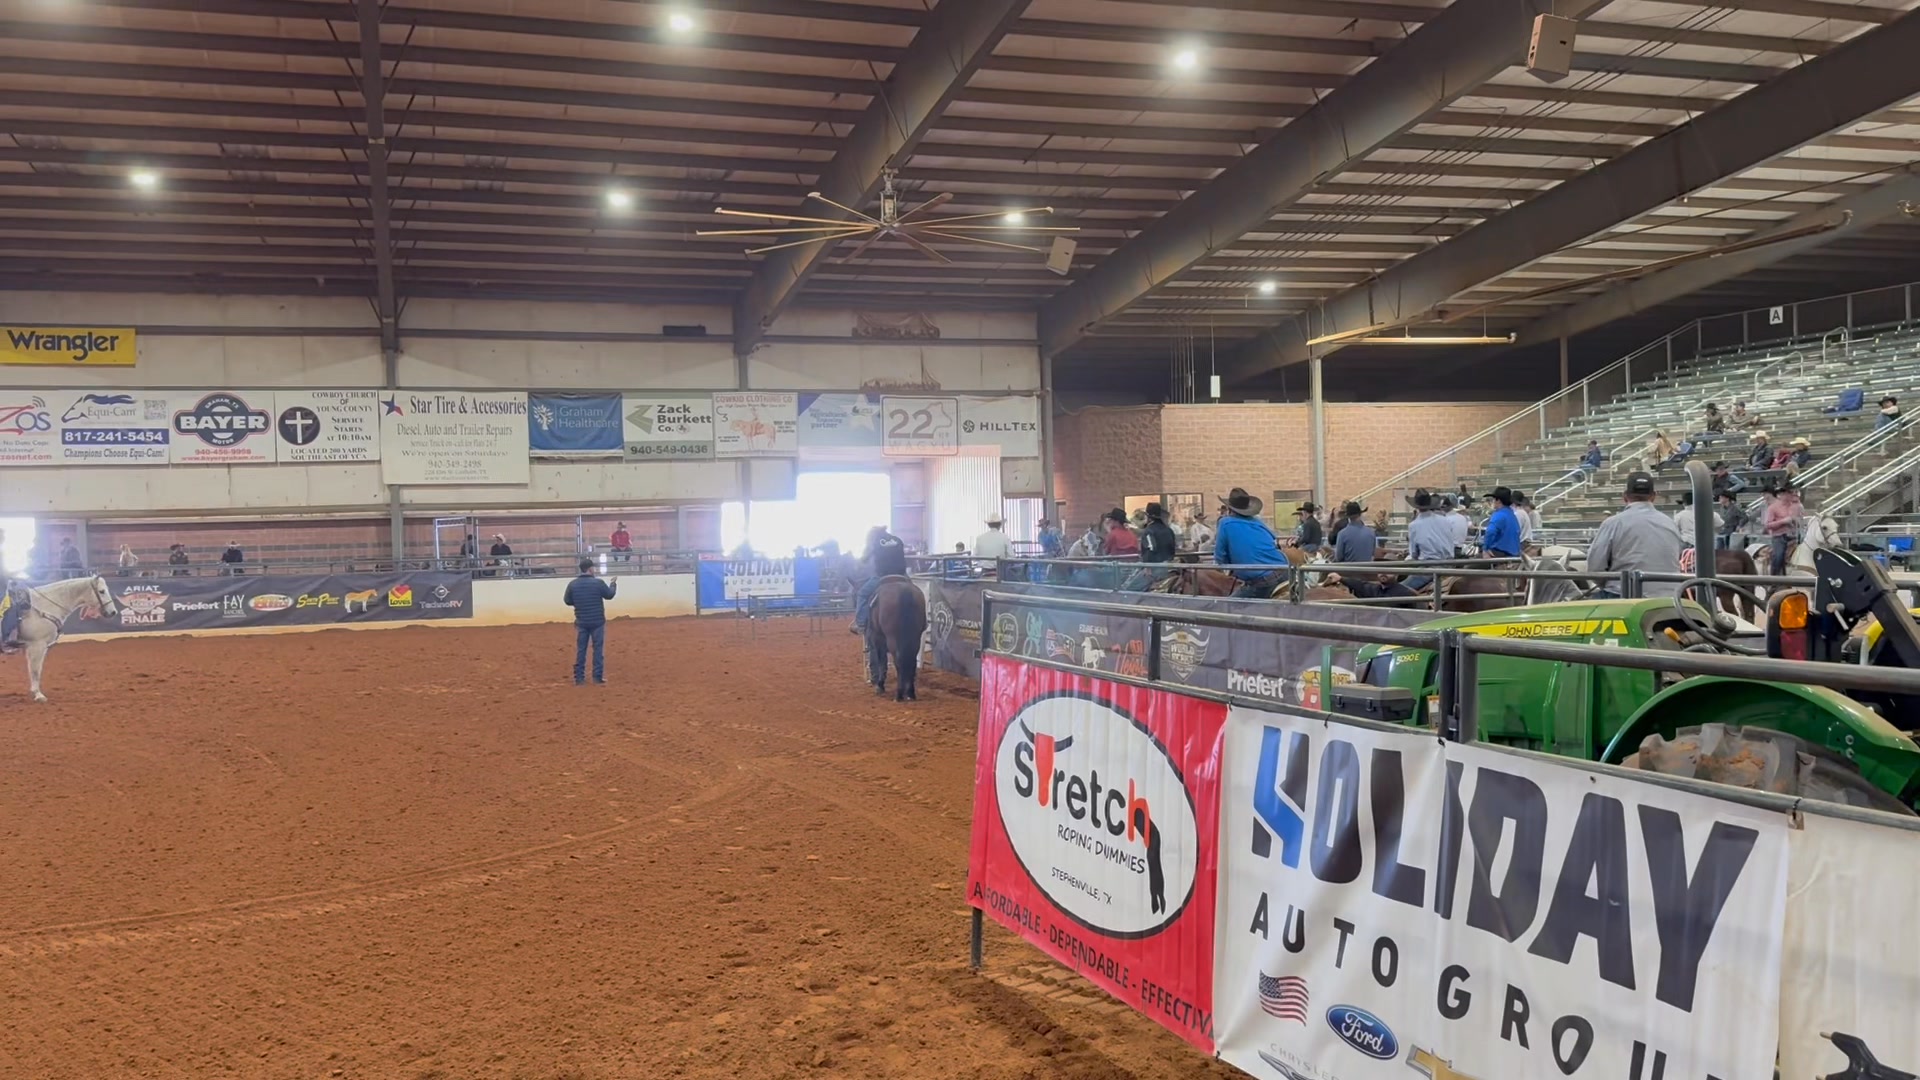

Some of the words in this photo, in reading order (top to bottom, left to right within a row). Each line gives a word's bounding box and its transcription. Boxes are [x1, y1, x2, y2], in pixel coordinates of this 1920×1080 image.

[1771, 309, 1781, 322] A
[7, 329, 120, 362] Wrangler
[410, 395, 432, 414] Star
[434, 395, 456, 414] Tire
[458, 395, 468, 414] &
[470, 396, 527, 415] Accessories
[559, 405, 604, 417] Graham
[656, 404, 691, 414] Zack
[180, 415, 265, 429] BAYER
[558, 417, 619, 429] Healthcare
[657, 414, 712, 424] Burkett
[887, 408, 934, 439] 22
[64, 431, 164, 442] 817-241-5454
[423, 424, 441, 436] Auto
[443, 424, 457, 436] and
[458, 424, 484, 436] Trailer
[486, 424, 513, 438] Repairs
[64, 448, 102, 460] Champions
[104, 448, 128, 458] Choose
[724, 560, 792, 577] HOLIDAY
[172, 601, 221, 611] Priefert
[223, 594, 245, 610] FAY
[121, 614, 166, 624] FINALE
[1502, 625, 1533, 637] JOHN
[1533, 624, 1572, 636] DEERE
[1227, 668, 1284, 698] Priefert
[1057, 823, 1093, 854] ROPING
[1094, 840, 1145, 875] DUMMIES
[1250, 724, 1760, 1014] HOLIDAY
[1051, 866, 1102, 902] STEPHENVILLE,
[1103, 890, 1112, 906] TX
[1049, 923, 1129, 990] DEPENDABLE
[1141, 978, 1213, 1040] EFFECTIV
[1249, 891, 1400, 988] AUTO
[1437, 964, 1724, 1080] GROU
[1341, 1012, 1384, 1053] Ford
